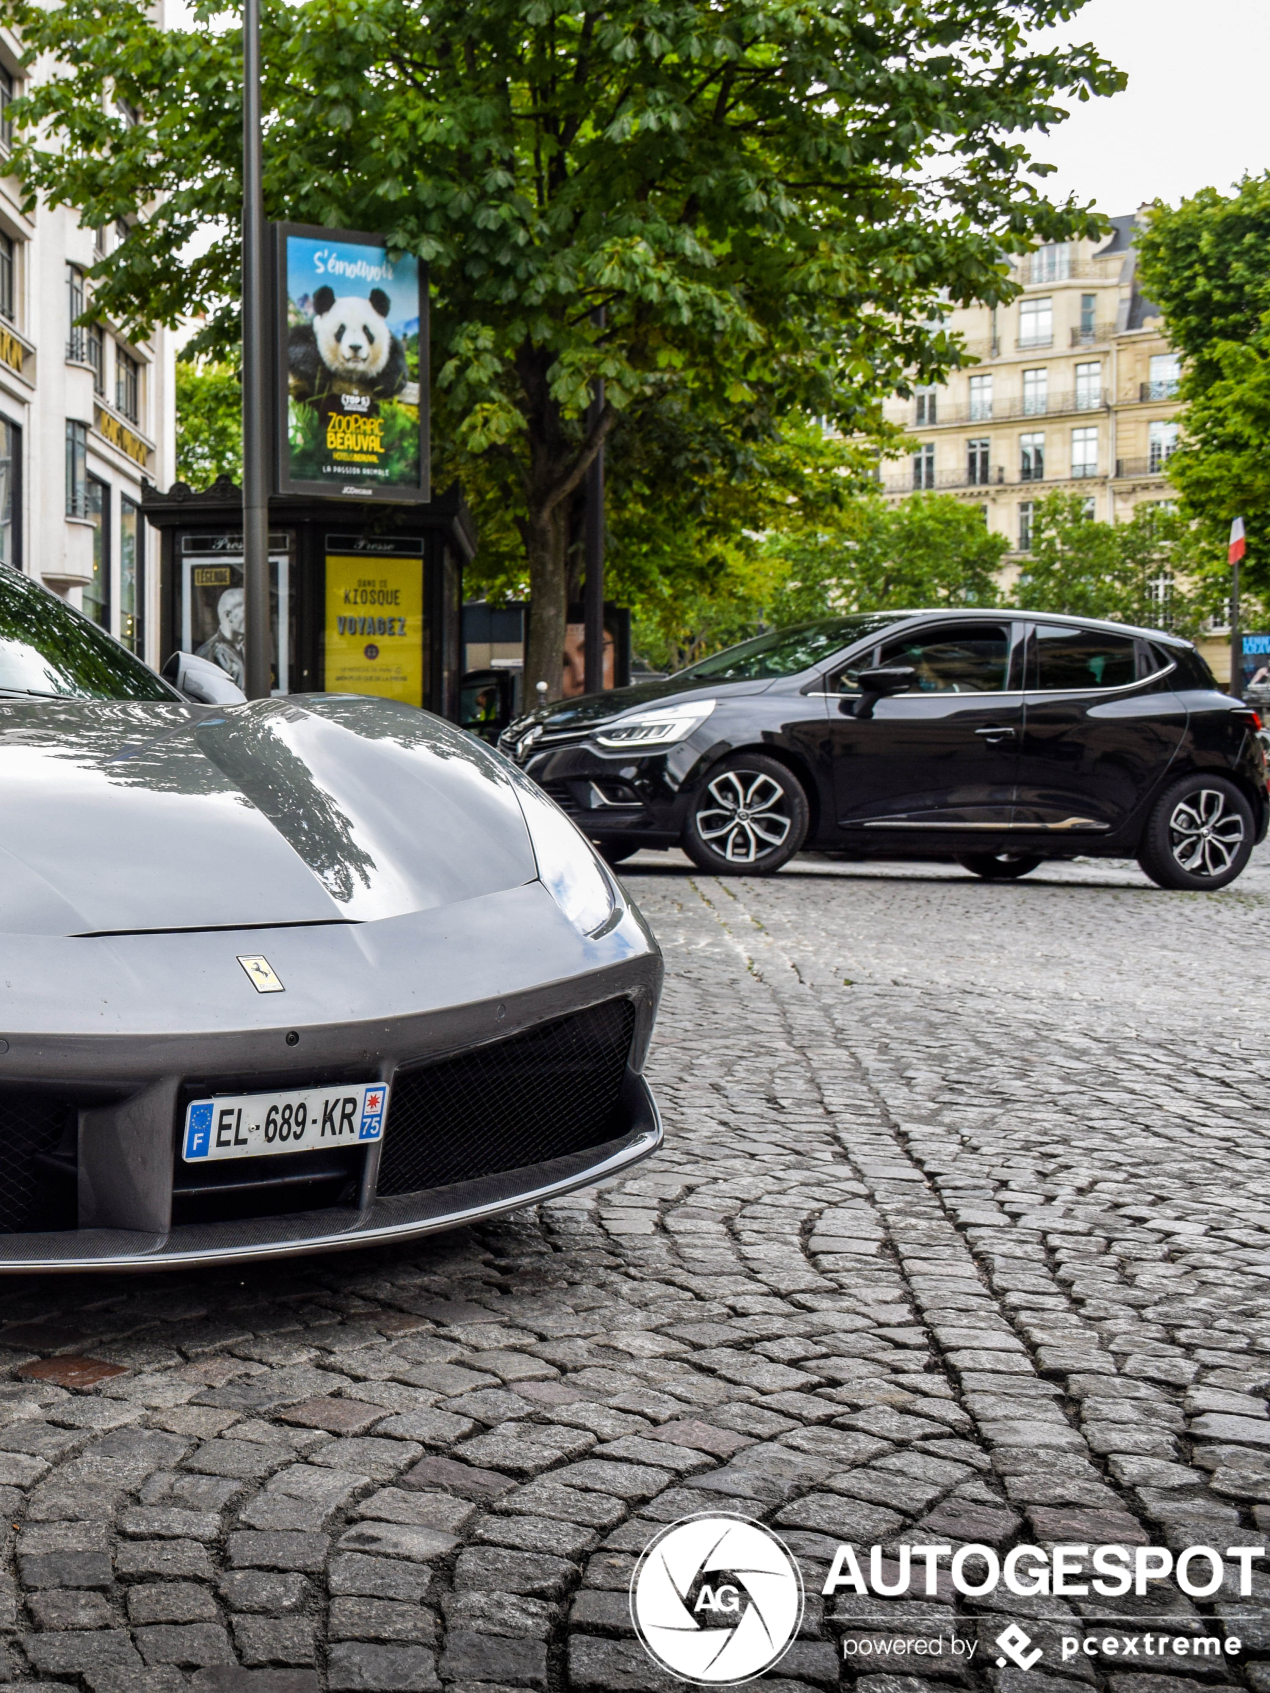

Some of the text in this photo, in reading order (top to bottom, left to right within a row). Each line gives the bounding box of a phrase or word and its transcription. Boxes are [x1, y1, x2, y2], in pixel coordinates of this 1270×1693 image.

[327, 432, 385, 453] BEAUVAL
[333, 466, 361, 475] PASSION
[362, 468, 389, 477] ANIMALE
[357, 579, 376, 588] DANS
[344, 589, 401, 606] KIOSQUE
[336, 616, 407, 636] VOYAGEZ
[362, 1116, 380, 1136] 75
[193, 1133, 204, 1151] F
